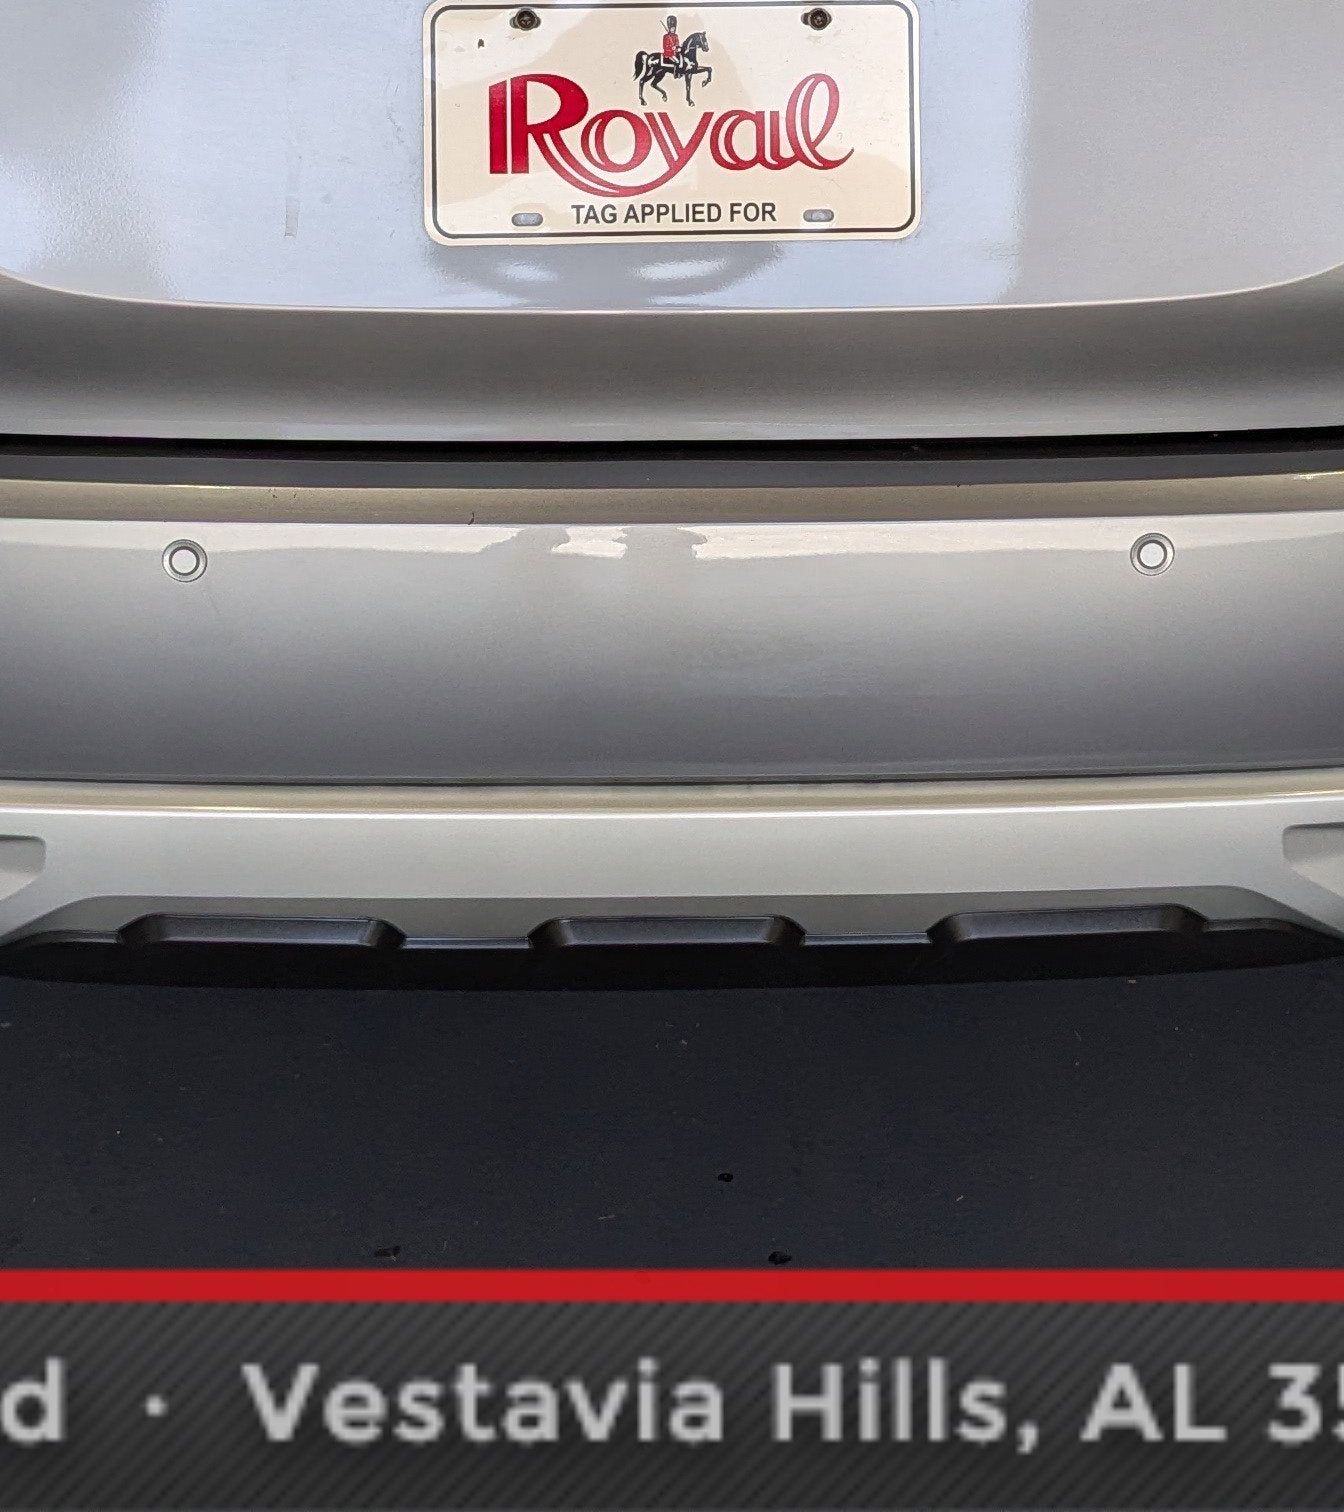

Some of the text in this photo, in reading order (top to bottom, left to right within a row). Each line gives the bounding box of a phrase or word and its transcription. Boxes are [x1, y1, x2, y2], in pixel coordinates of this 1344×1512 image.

[488, 72, 854, 198] Royal
[571, 201, 778, 225] TAG APPLIED FOR
